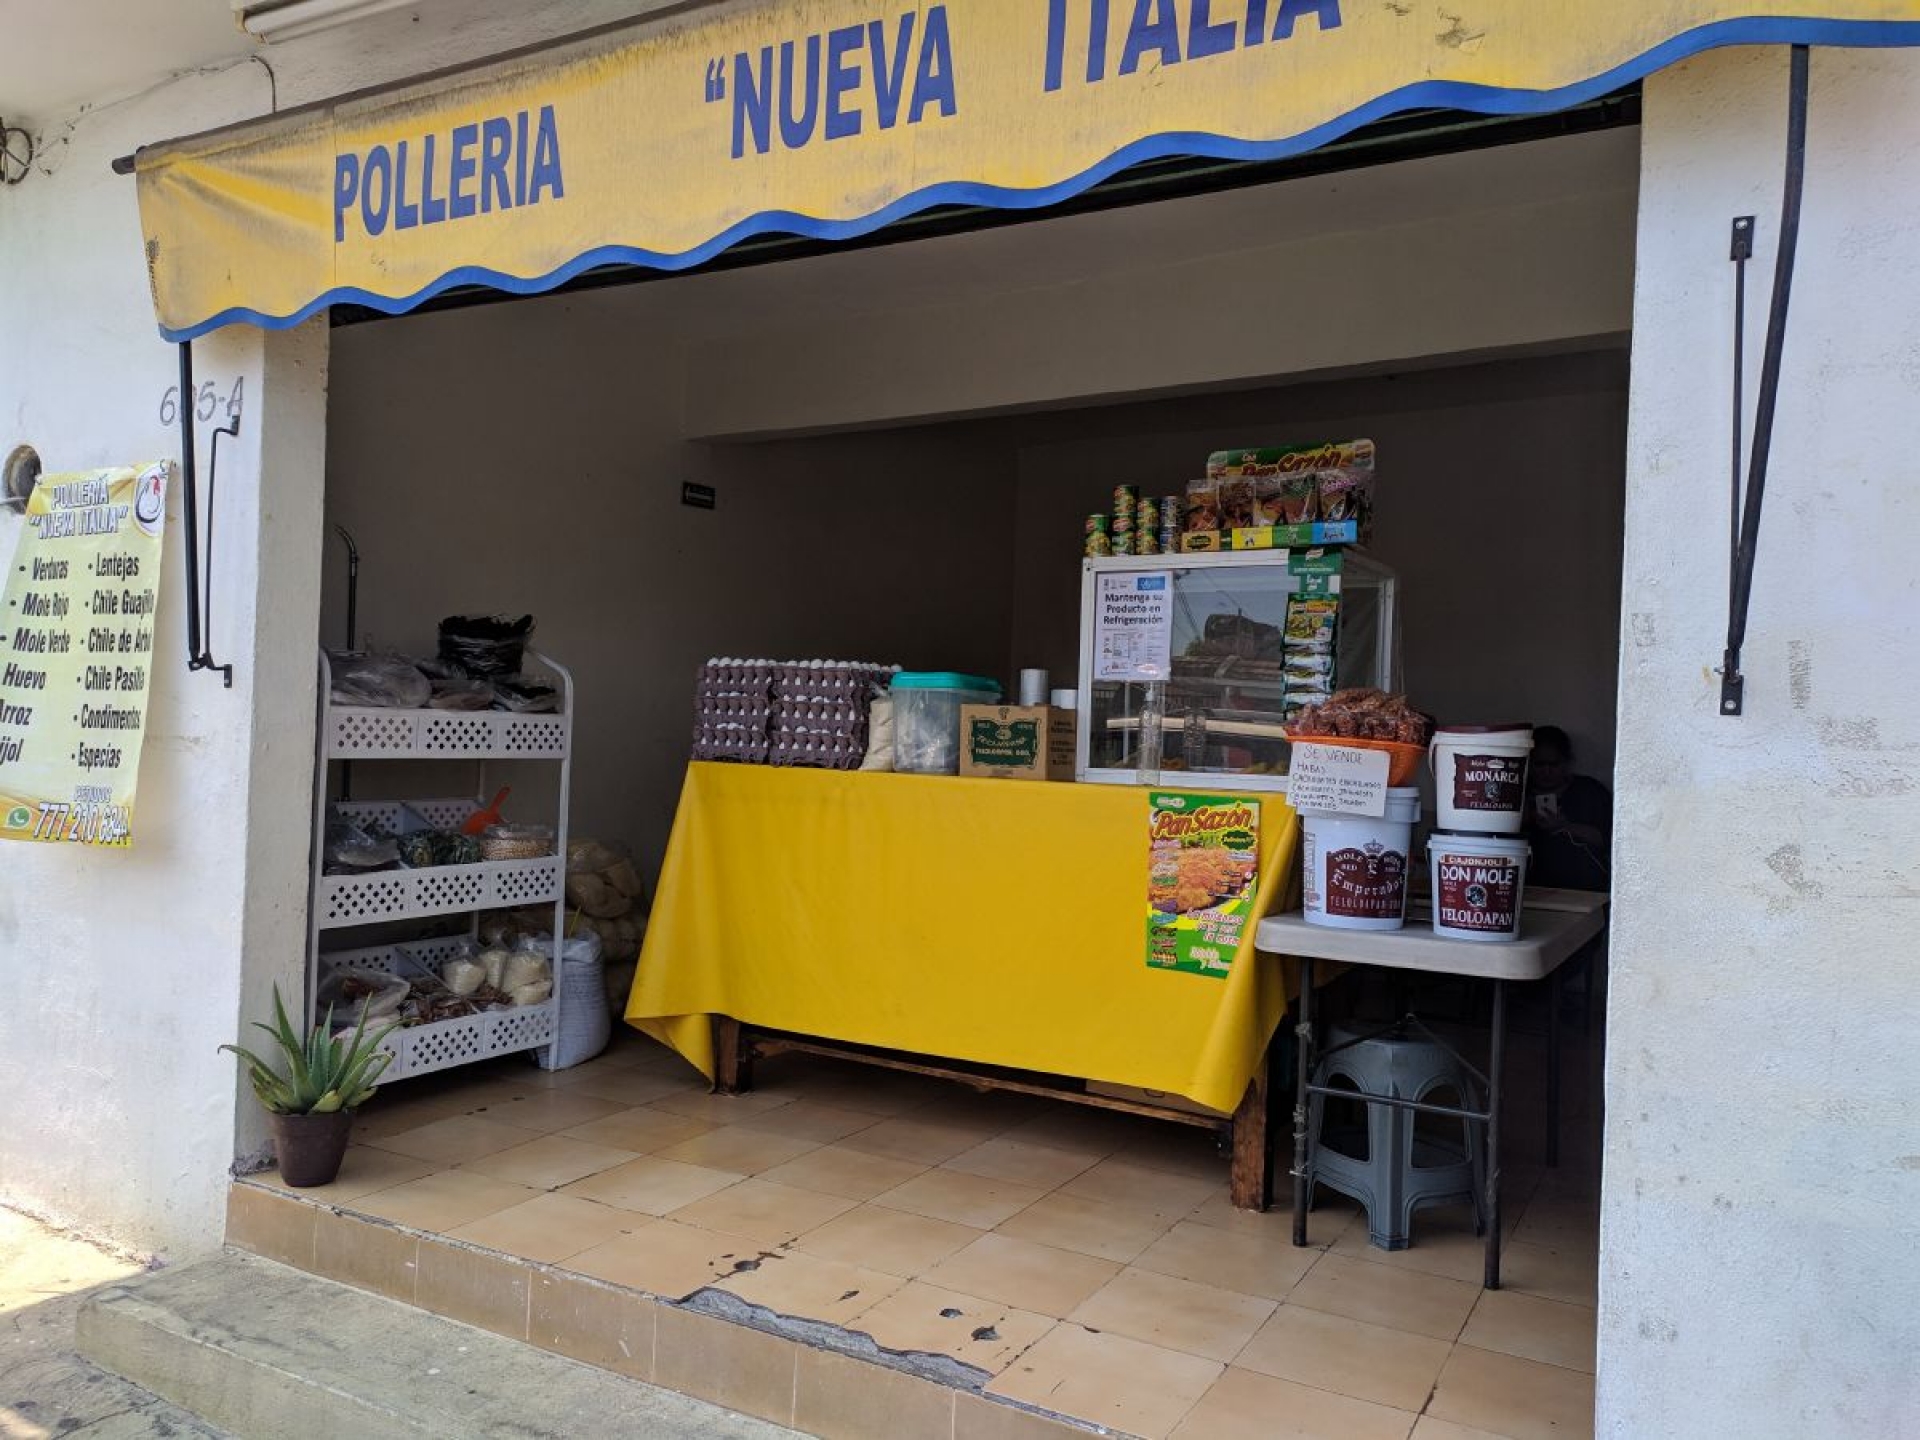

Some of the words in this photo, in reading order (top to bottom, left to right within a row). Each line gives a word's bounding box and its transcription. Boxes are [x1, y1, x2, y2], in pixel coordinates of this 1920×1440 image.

[335, 104, 564, 242] POLLERIA
[705, 5, 957, 159] “NUEVA
[33, 557, 69, 581] Verduras
[96, 552, 139, 581] Lentejas
[22, 592, 51, 617] Mole
[53, 592, 70, 621] Rojo
[92, 589, 118, 615] Chile
[1105, 593, 1150, 604] Mantenga
[1106, 604, 1147, 613] Producto
[1103, 614, 1163, 626] Refrigeración
[13, 627, 46, 653] Mole
[48, 628, 70, 653] Verde
[88, 627, 115, 653] Chile
[118, 629, 132, 652] de
[3, 662, 46, 690] Huevo
[85, 665, 111, 690] Chile
[1303, 743, 1319, 759] SE
[1325, 748, 1363, 763] VENDE
[1297, 761, 1326, 774] HABAS
[1465, 771, 1520, 785] MONARCA
[33, 801, 71, 839] 777
[68, 803, 100, 842] 210
[1334, 852, 1364, 863] MOLE
[1441, 865, 1471, 882] DON
[1475, 868, 1513, 884] MOLE
[1442, 907, 1513, 926] TELOLOAPAN
